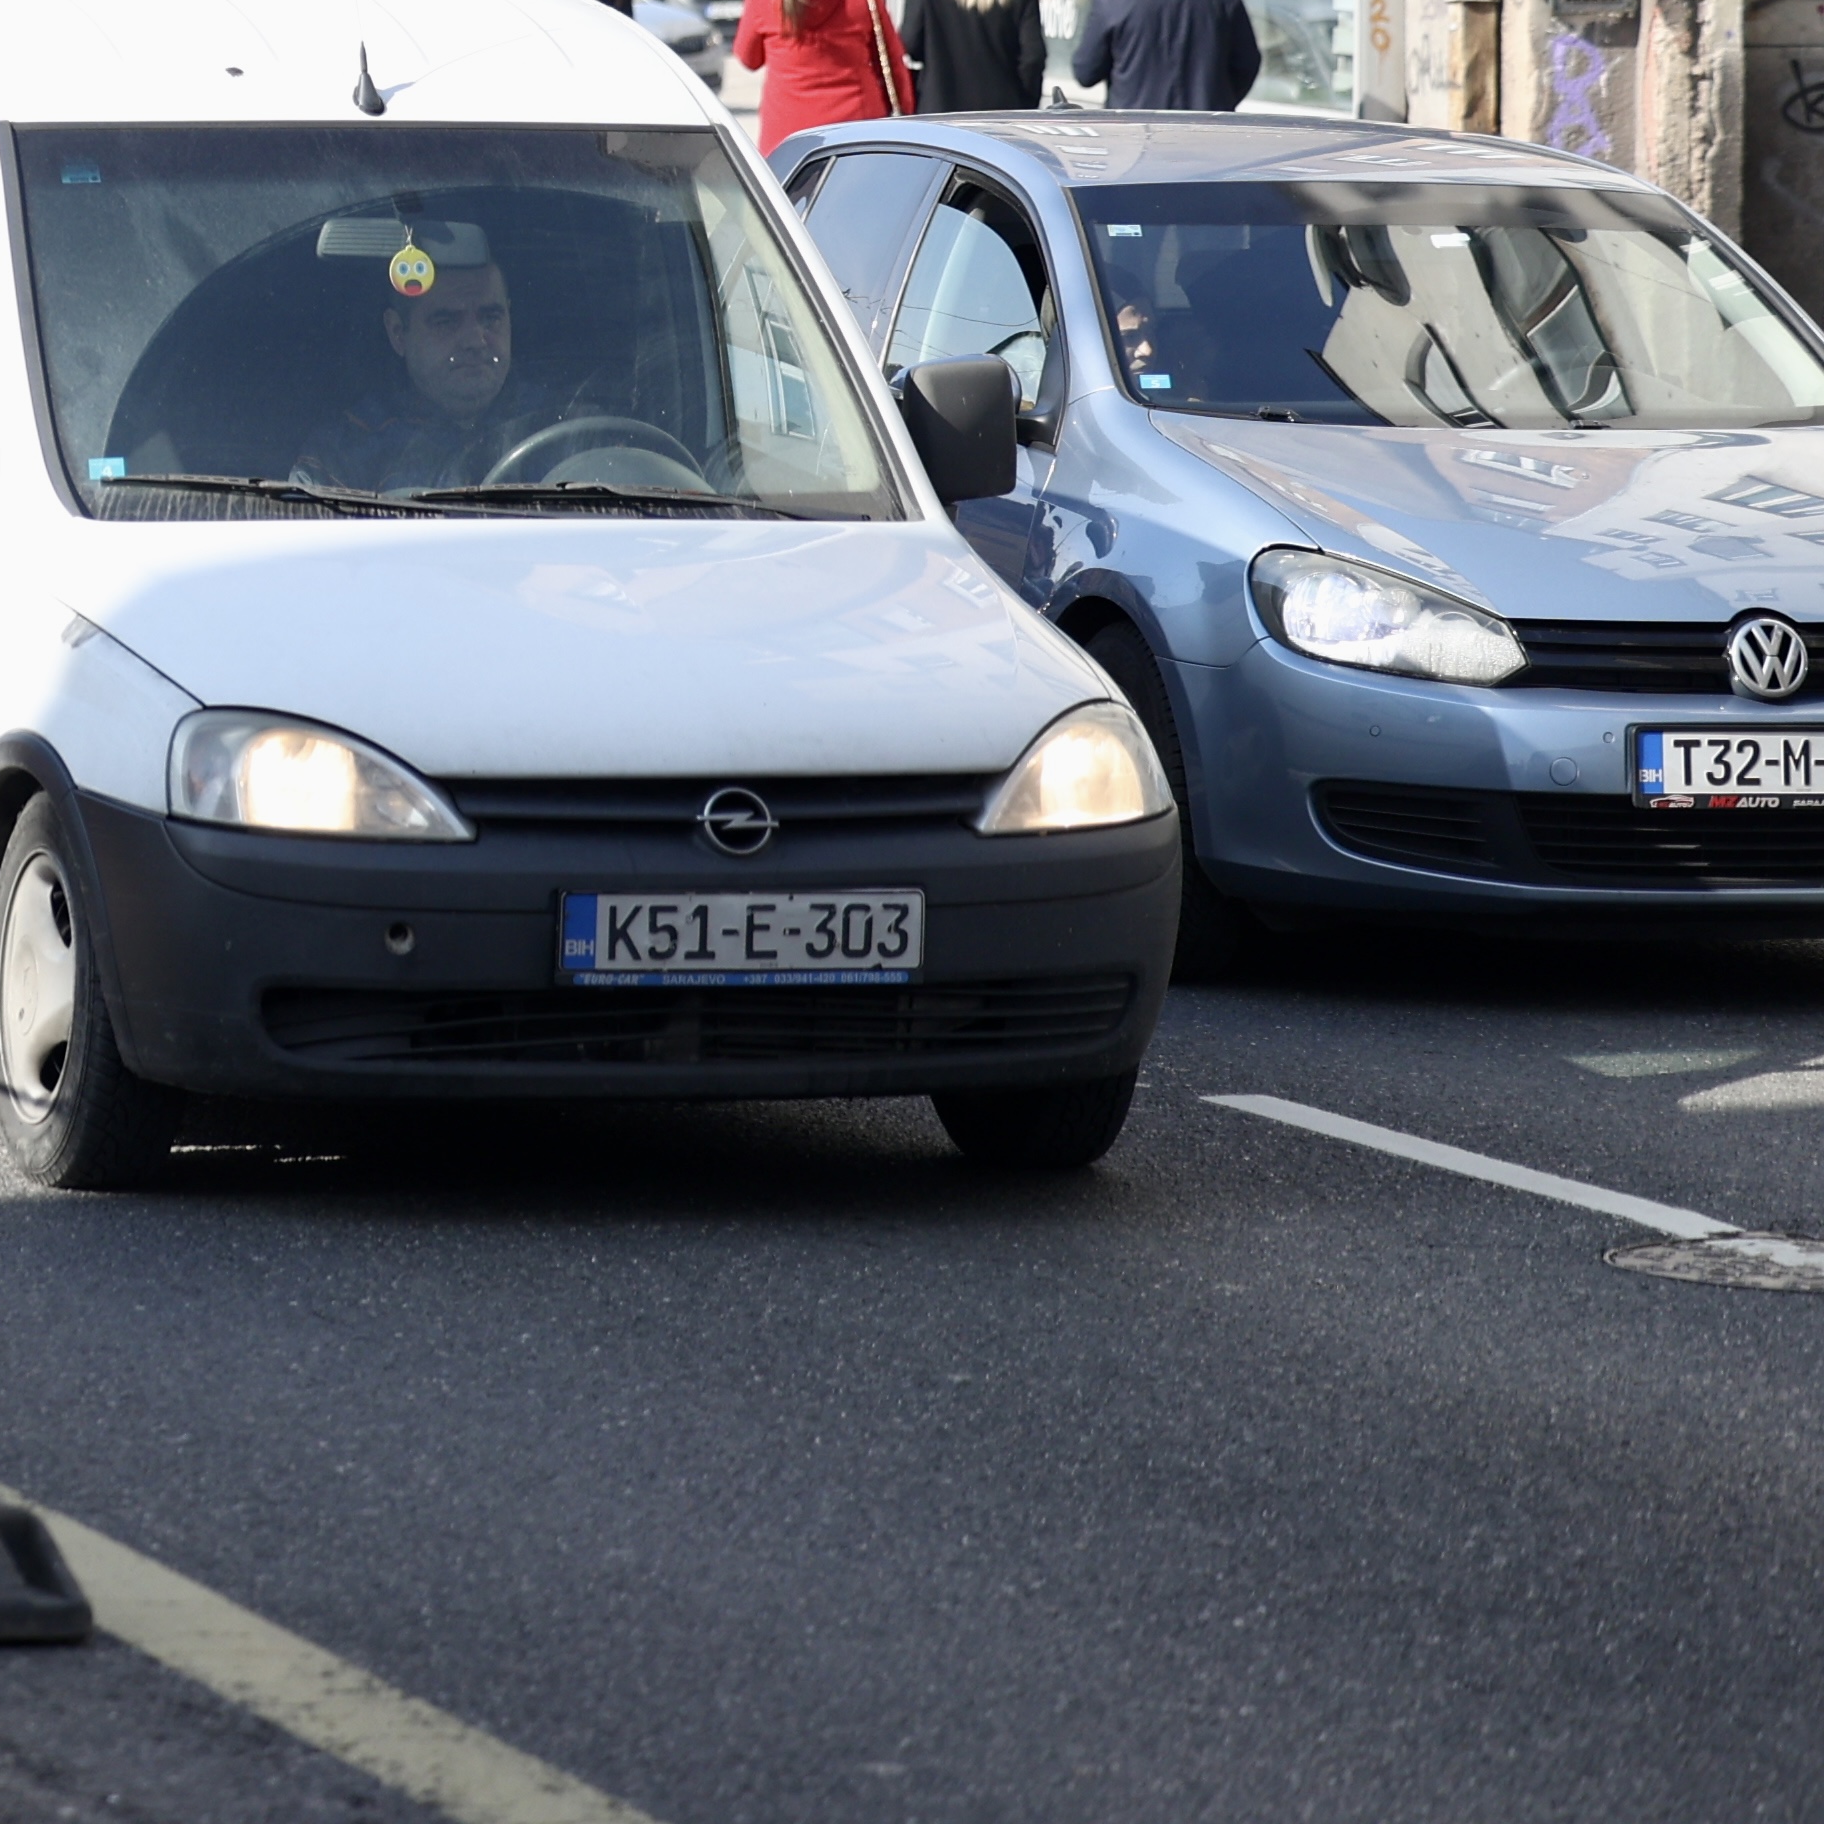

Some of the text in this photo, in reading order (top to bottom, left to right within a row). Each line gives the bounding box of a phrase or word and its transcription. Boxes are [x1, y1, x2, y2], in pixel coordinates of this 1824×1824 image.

[1639, 768, 1663, 783] BIH
[606, 903, 910, 962] K51-E-303
[565, 938, 595, 956] BIH
[662, 973, 726, 986] SARAJEVO
